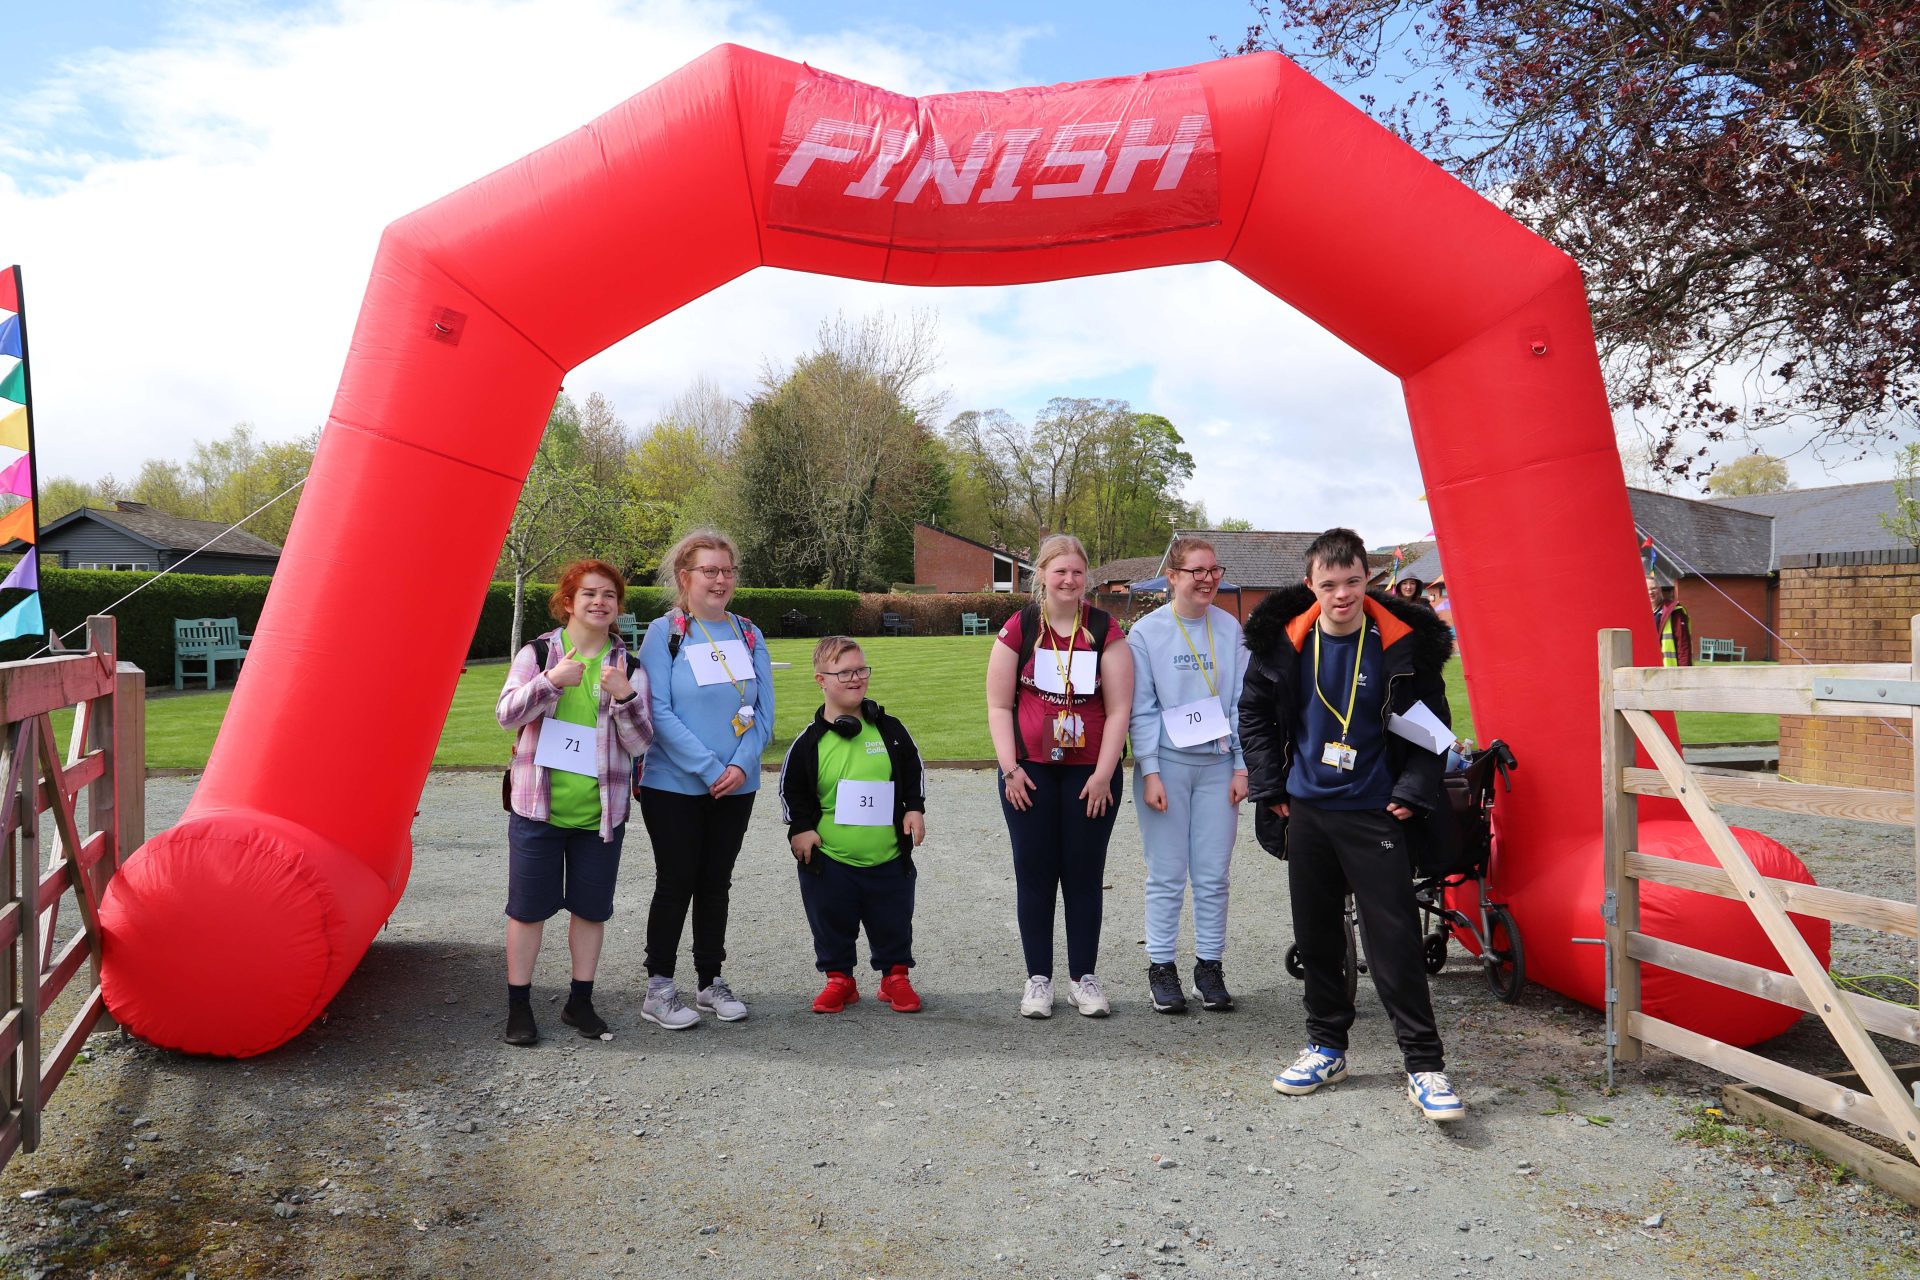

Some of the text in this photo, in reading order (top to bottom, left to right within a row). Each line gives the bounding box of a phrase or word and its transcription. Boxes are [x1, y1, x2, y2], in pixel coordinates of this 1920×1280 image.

[774, 114, 1206, 204] FINISH
[1192, 661, 1214, 671] CUB
[1186, 711, 1202, 725] 70
[565, 738, 580, 753] 71
[859, 796, 875, 808] 31
